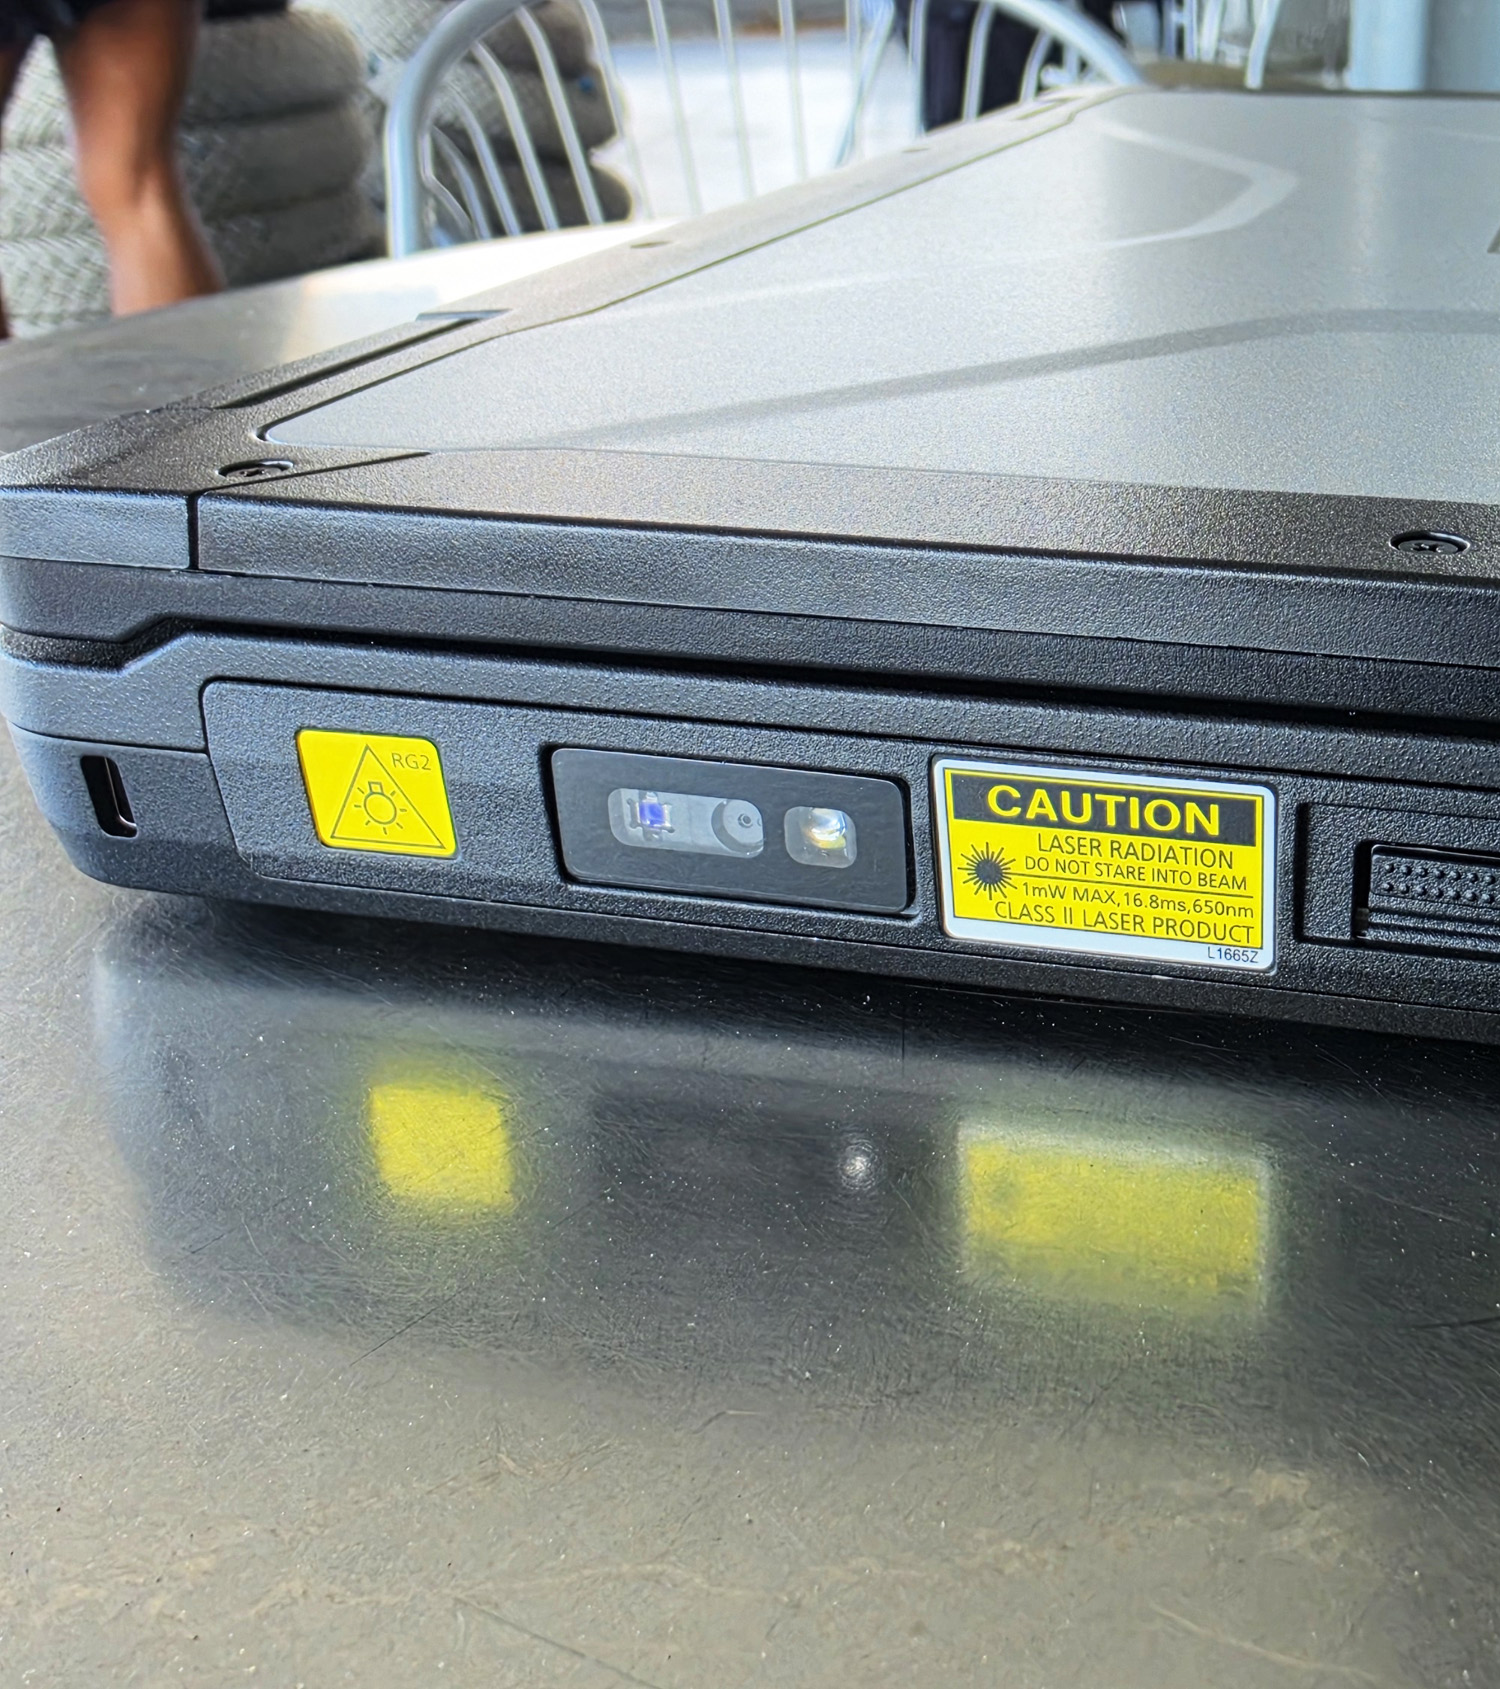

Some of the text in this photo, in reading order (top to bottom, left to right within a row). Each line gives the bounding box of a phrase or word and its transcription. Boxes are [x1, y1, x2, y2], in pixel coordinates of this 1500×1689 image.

[391, 753, 432, 771] RG2
[987, 785, 1220, 836] CAUTION
[1038, 833, 1233, 869] LASER RADIATION
[1026, 856, 1247, 890] DO NOT STARE INTO BEAM
[1022, 881, 1066, 900] 1mW
[995, 901, 1254, 944] CLASS II LASER PRODUCT
[1207, 947, 1259, 964] L1665Z
